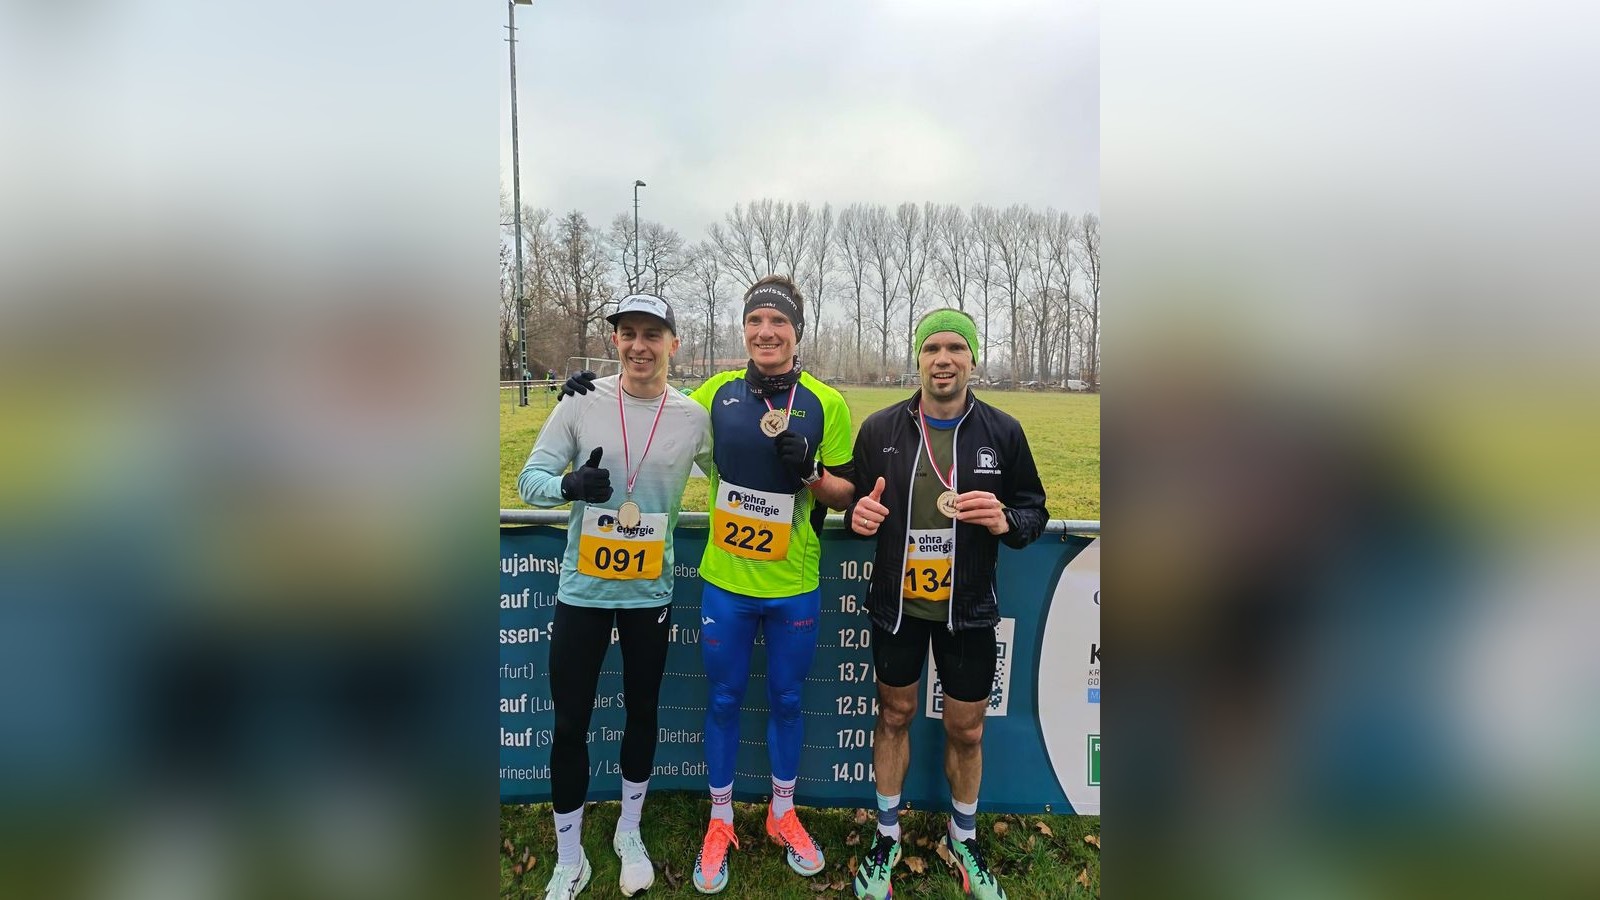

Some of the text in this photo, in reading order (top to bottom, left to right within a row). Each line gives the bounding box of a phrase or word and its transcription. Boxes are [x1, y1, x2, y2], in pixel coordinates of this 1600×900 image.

[744, 503, 779, 517] energie
[745, 494, 766, 506] ohra
[724, 522, 774, 553] 222
[919, 534, 942, 544] ohra
[500, 553, 562, 577] ujahrsl
[840, 560, 873, 582] 10,0
[595, 547, 646, 572] 091
[905, 567, 952, 593] 134
[500, 588, 530, 609] auf
[839, 594, 870, 616] 16,
[838, 628, 870, 650] 12,0
[500, 662, 534, 680] rfurt)
[837, 662, 869, 684] 13,7
[500, 693, 528, 713] auf
[836, 695, 867, 717] 12,5
[500, 727, 533, 747] lauf
[837, 729, 866, 750] 17,0
[832, 762, 864, 784] 14,0
